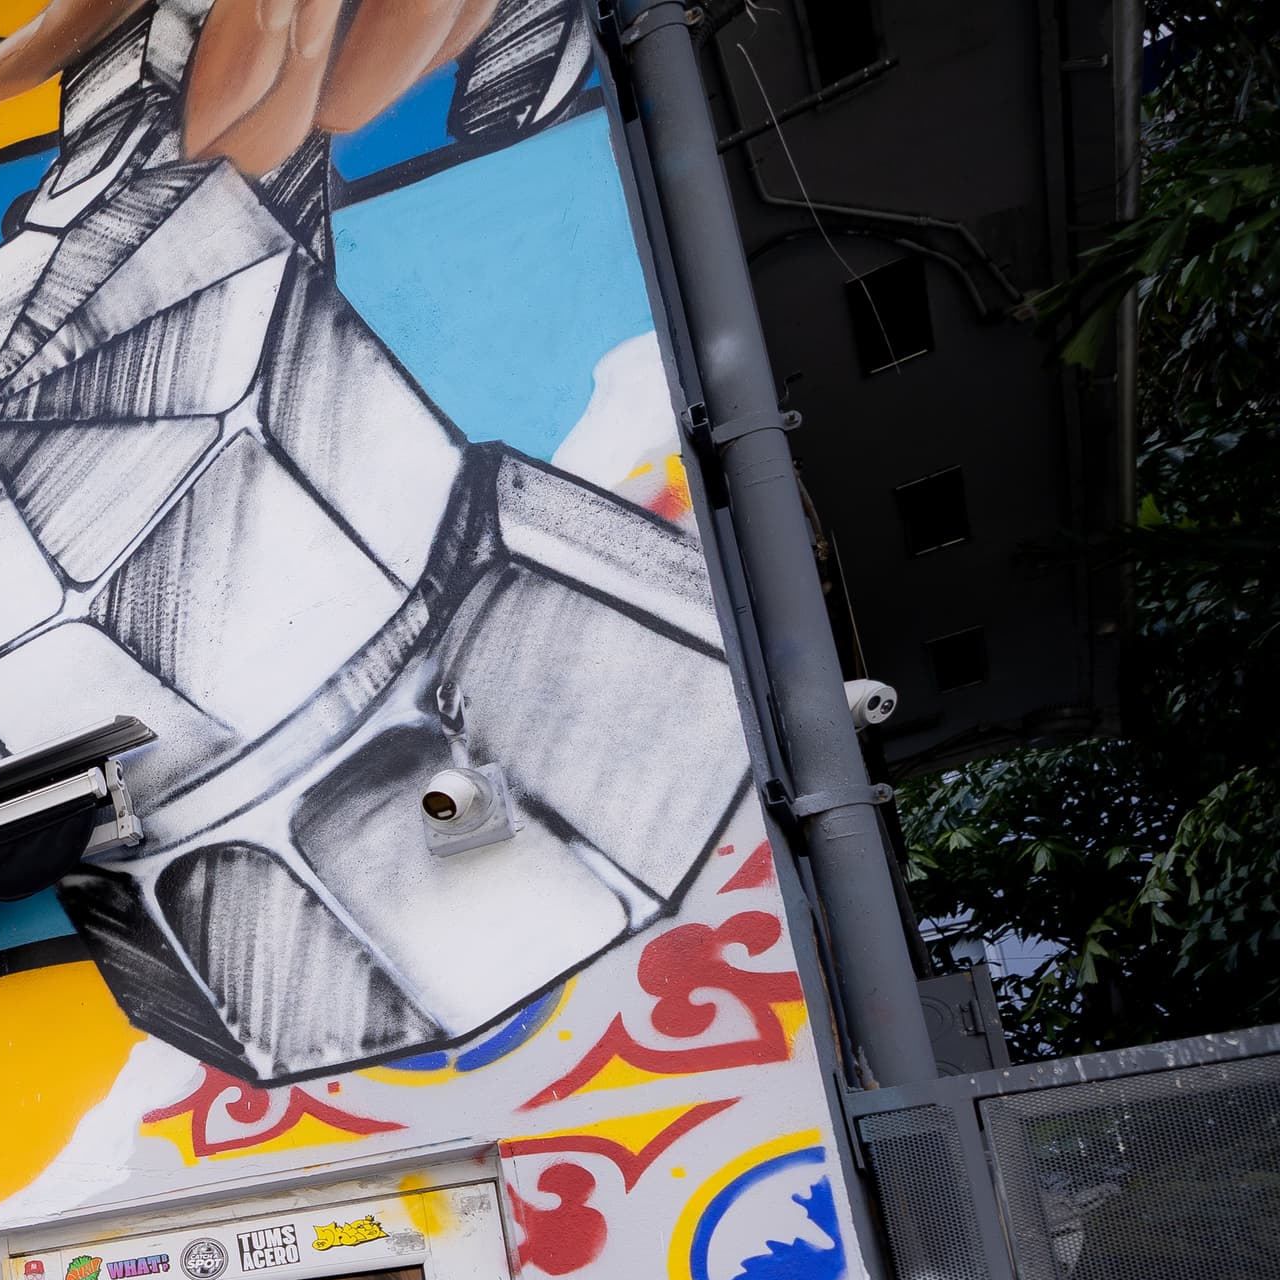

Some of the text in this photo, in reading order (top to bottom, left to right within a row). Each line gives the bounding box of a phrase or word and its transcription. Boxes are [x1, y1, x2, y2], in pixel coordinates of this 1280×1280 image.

[239, 1226, 295, 1252] TUMS
[187, 1258, 223, 1270] SPOT
[241, 1244, 300, 1272] ACERO
